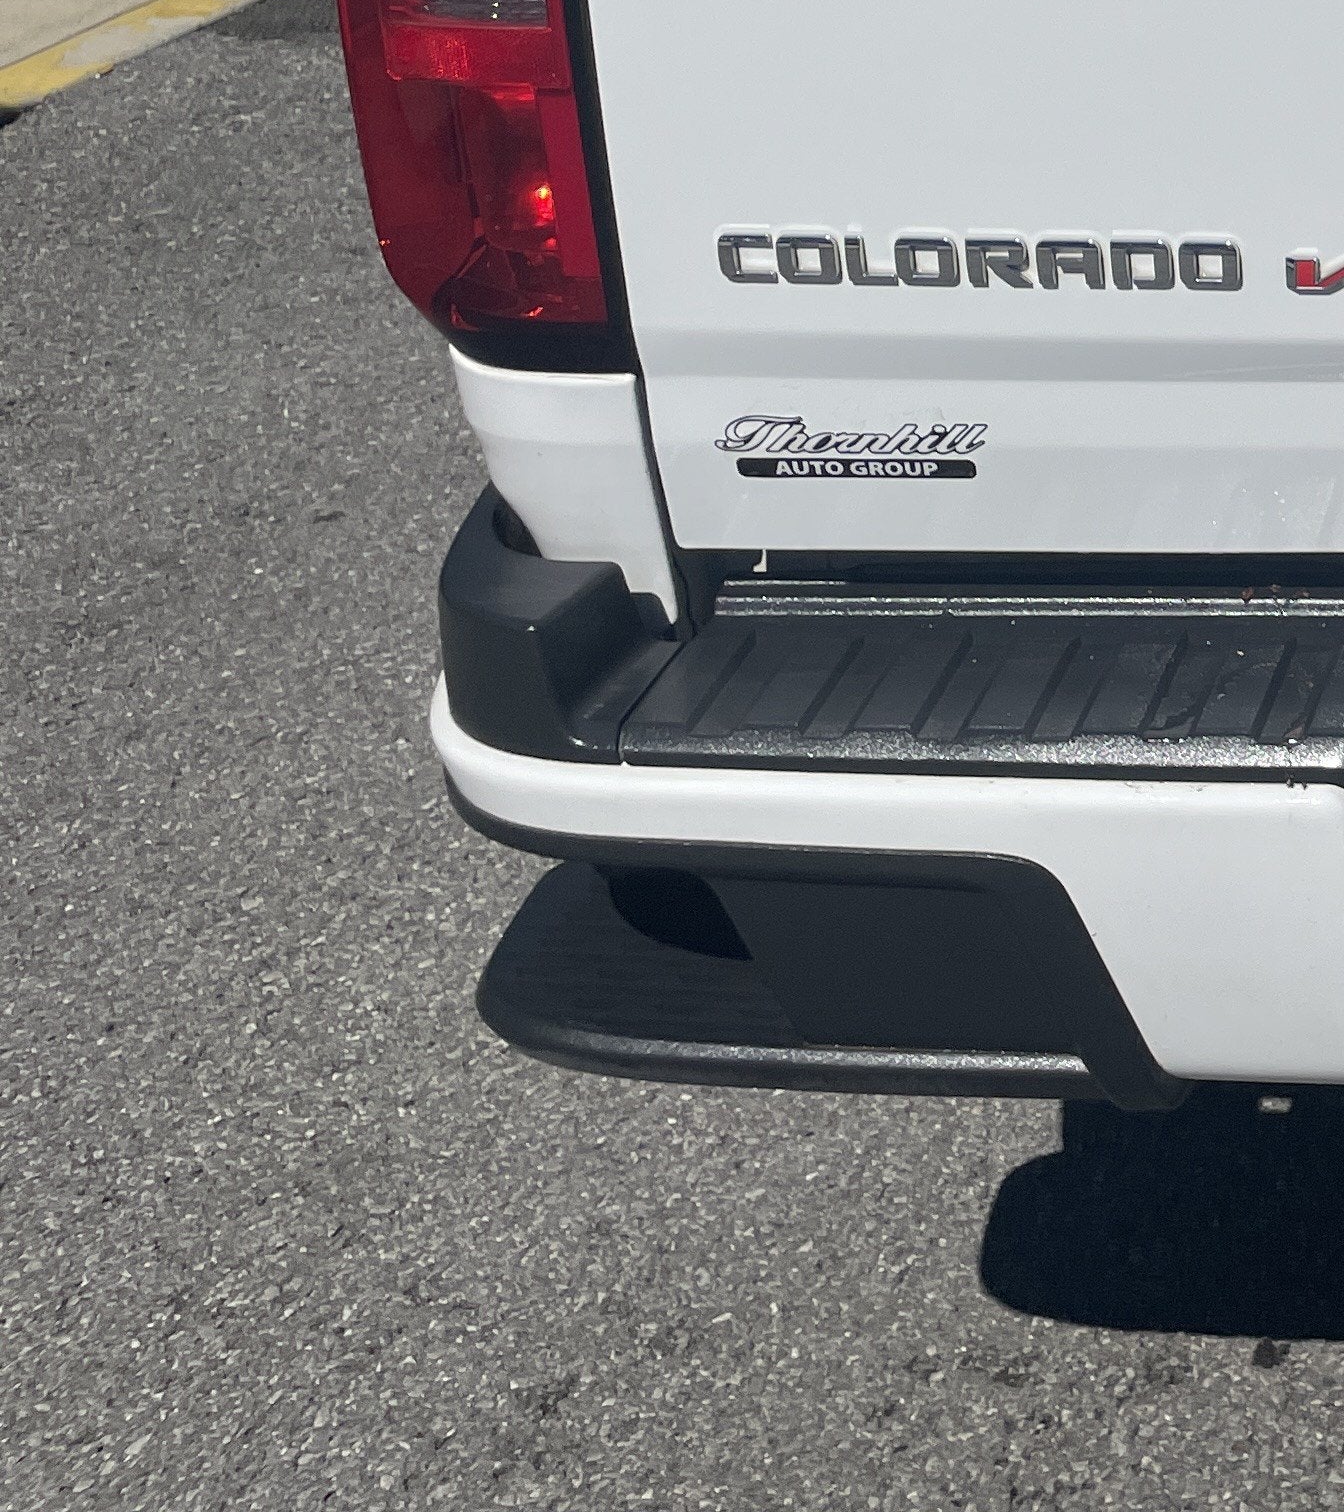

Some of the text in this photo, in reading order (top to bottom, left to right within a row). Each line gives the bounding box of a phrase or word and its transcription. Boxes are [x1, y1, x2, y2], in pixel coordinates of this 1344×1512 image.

[717, 231, 1244, 291] COLORADO
[714, 414, 988, 455] Thornhill
[775, 461, 940, 476] AUTO GROUP
